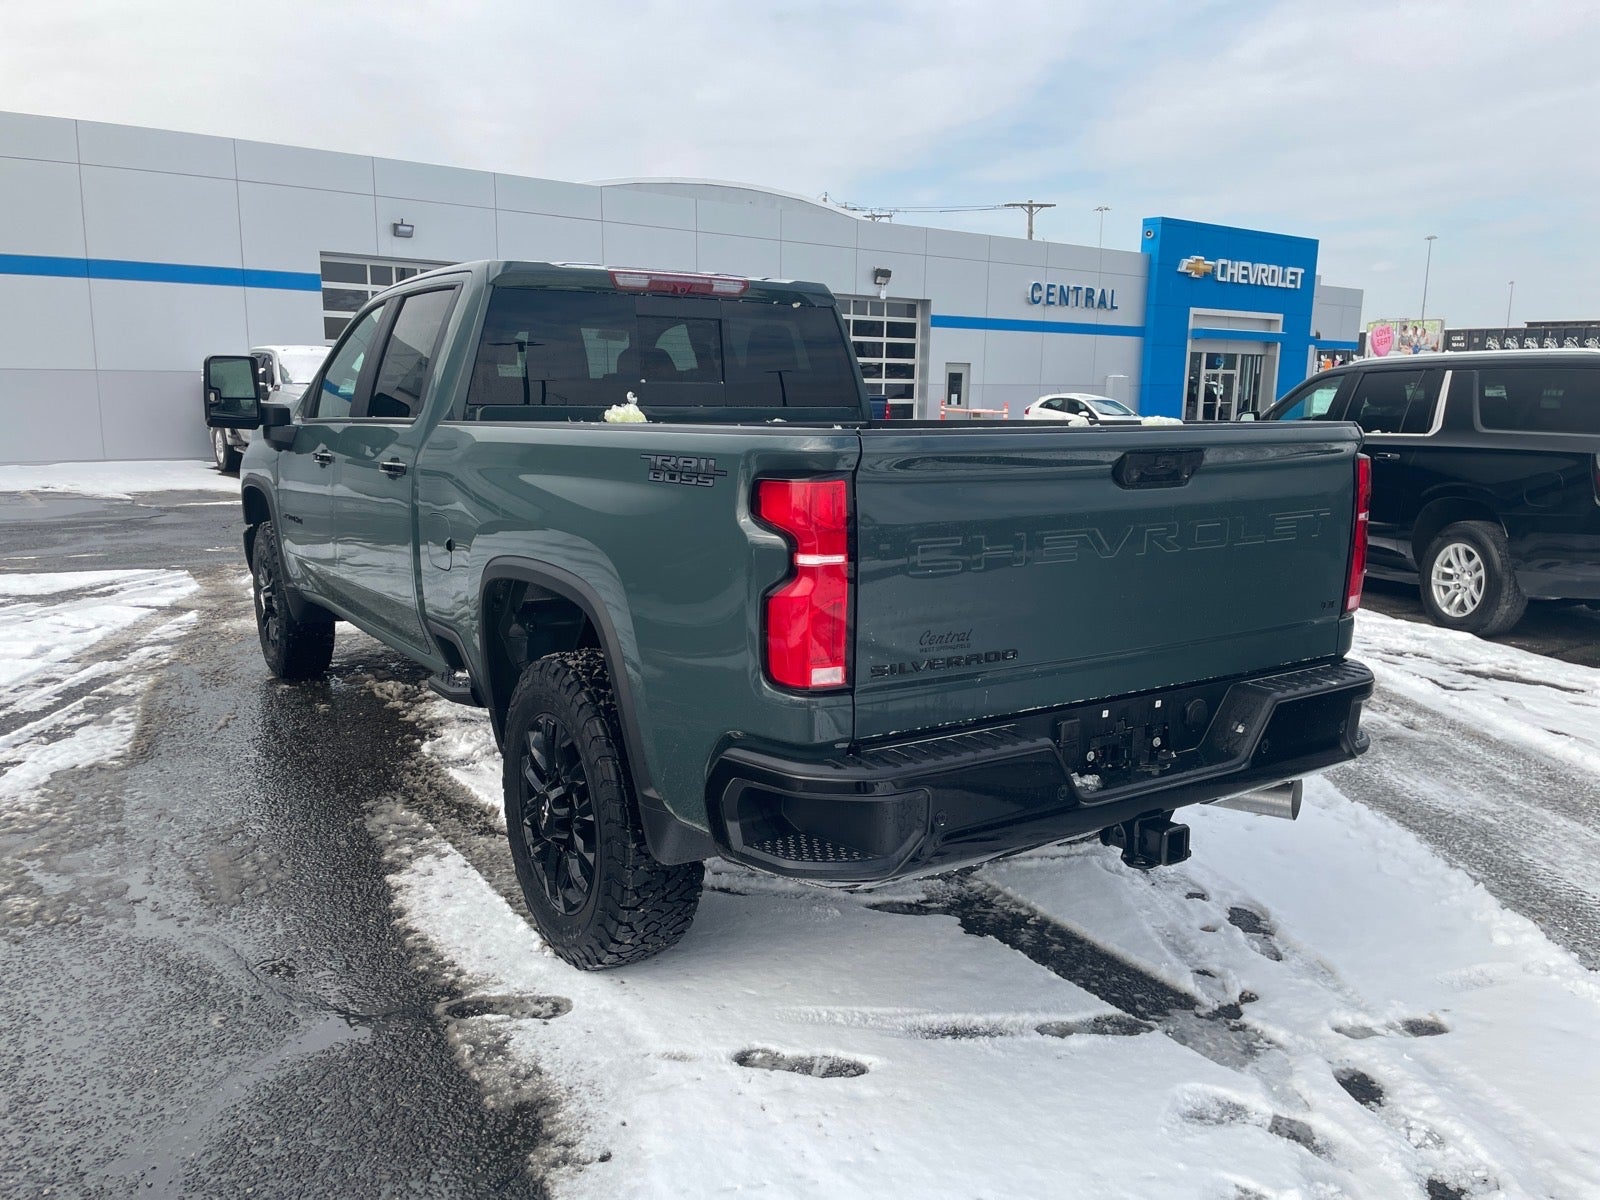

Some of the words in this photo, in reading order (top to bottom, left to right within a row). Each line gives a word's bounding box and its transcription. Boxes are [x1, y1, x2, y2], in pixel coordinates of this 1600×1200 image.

[1216, 258, 1305, 289] CHEVROLET
[1028, 281, 1118, 310] CENTRAL
[1375, 326, 1391, 337] LOVE
[1376, 336, 1392, 347] SEAT
[640, 453, 728, 476] TRAIL
[647, 469, 715, 487] BOSS
[907, 507, 1331, 576] CHEVROLET
[919, 628, 973, 646] Central
[870, 648, 1019, 678] SILVERADO
